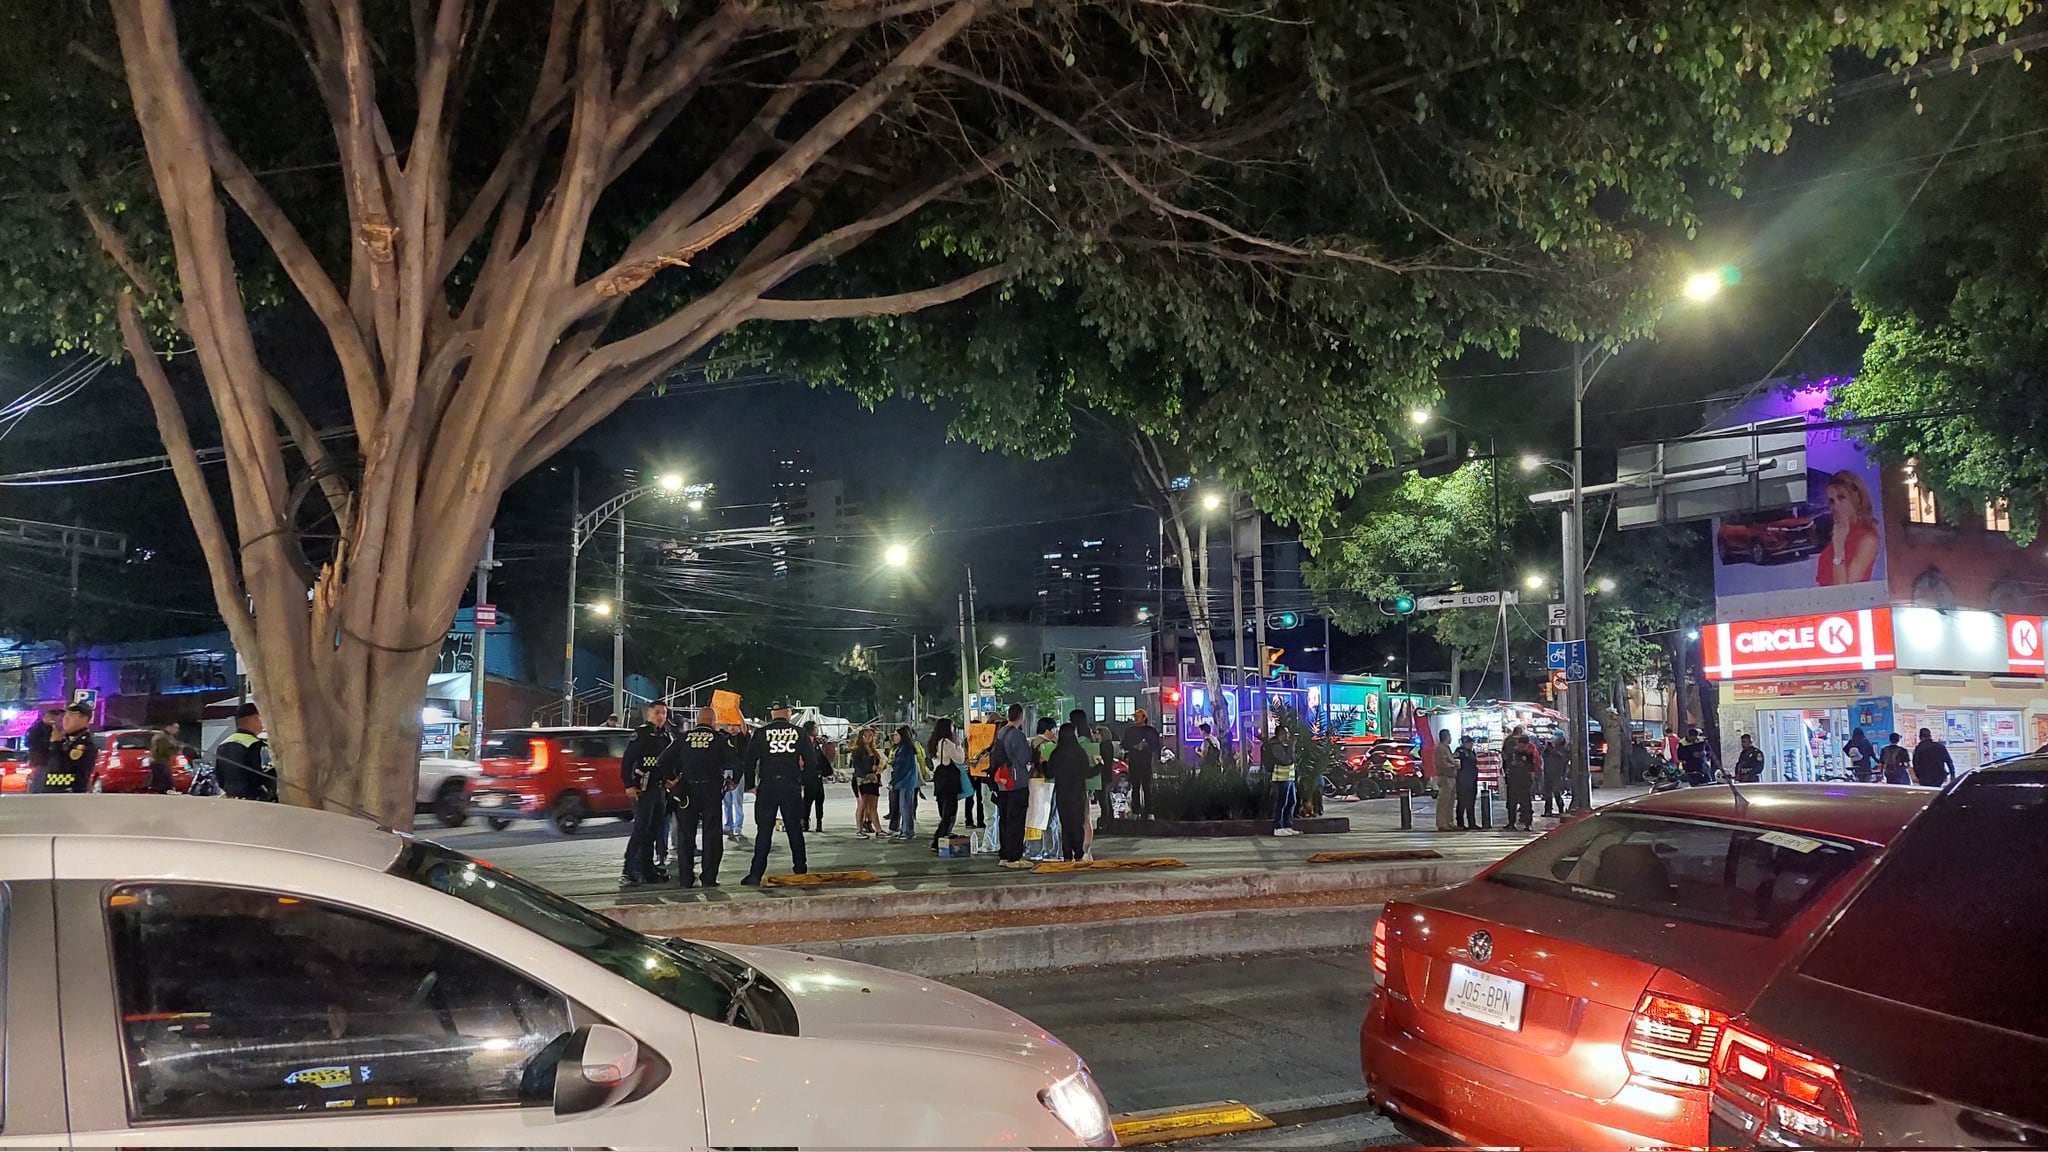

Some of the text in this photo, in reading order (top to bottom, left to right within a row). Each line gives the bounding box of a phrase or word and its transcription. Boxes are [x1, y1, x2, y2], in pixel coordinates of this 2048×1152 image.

[1462, 595, 1496, 605] EL ORO
[1554, 609, 1565, 619] 2
[1735, 616, 1854, 654] CIRCLE K
[766, 727, 798, 737] POLICÍA
[691, 741, 710, 749] SSC
[769, 740, 796, 754] SSC
[1457, 979, 1511, 1012] J05-BPN
